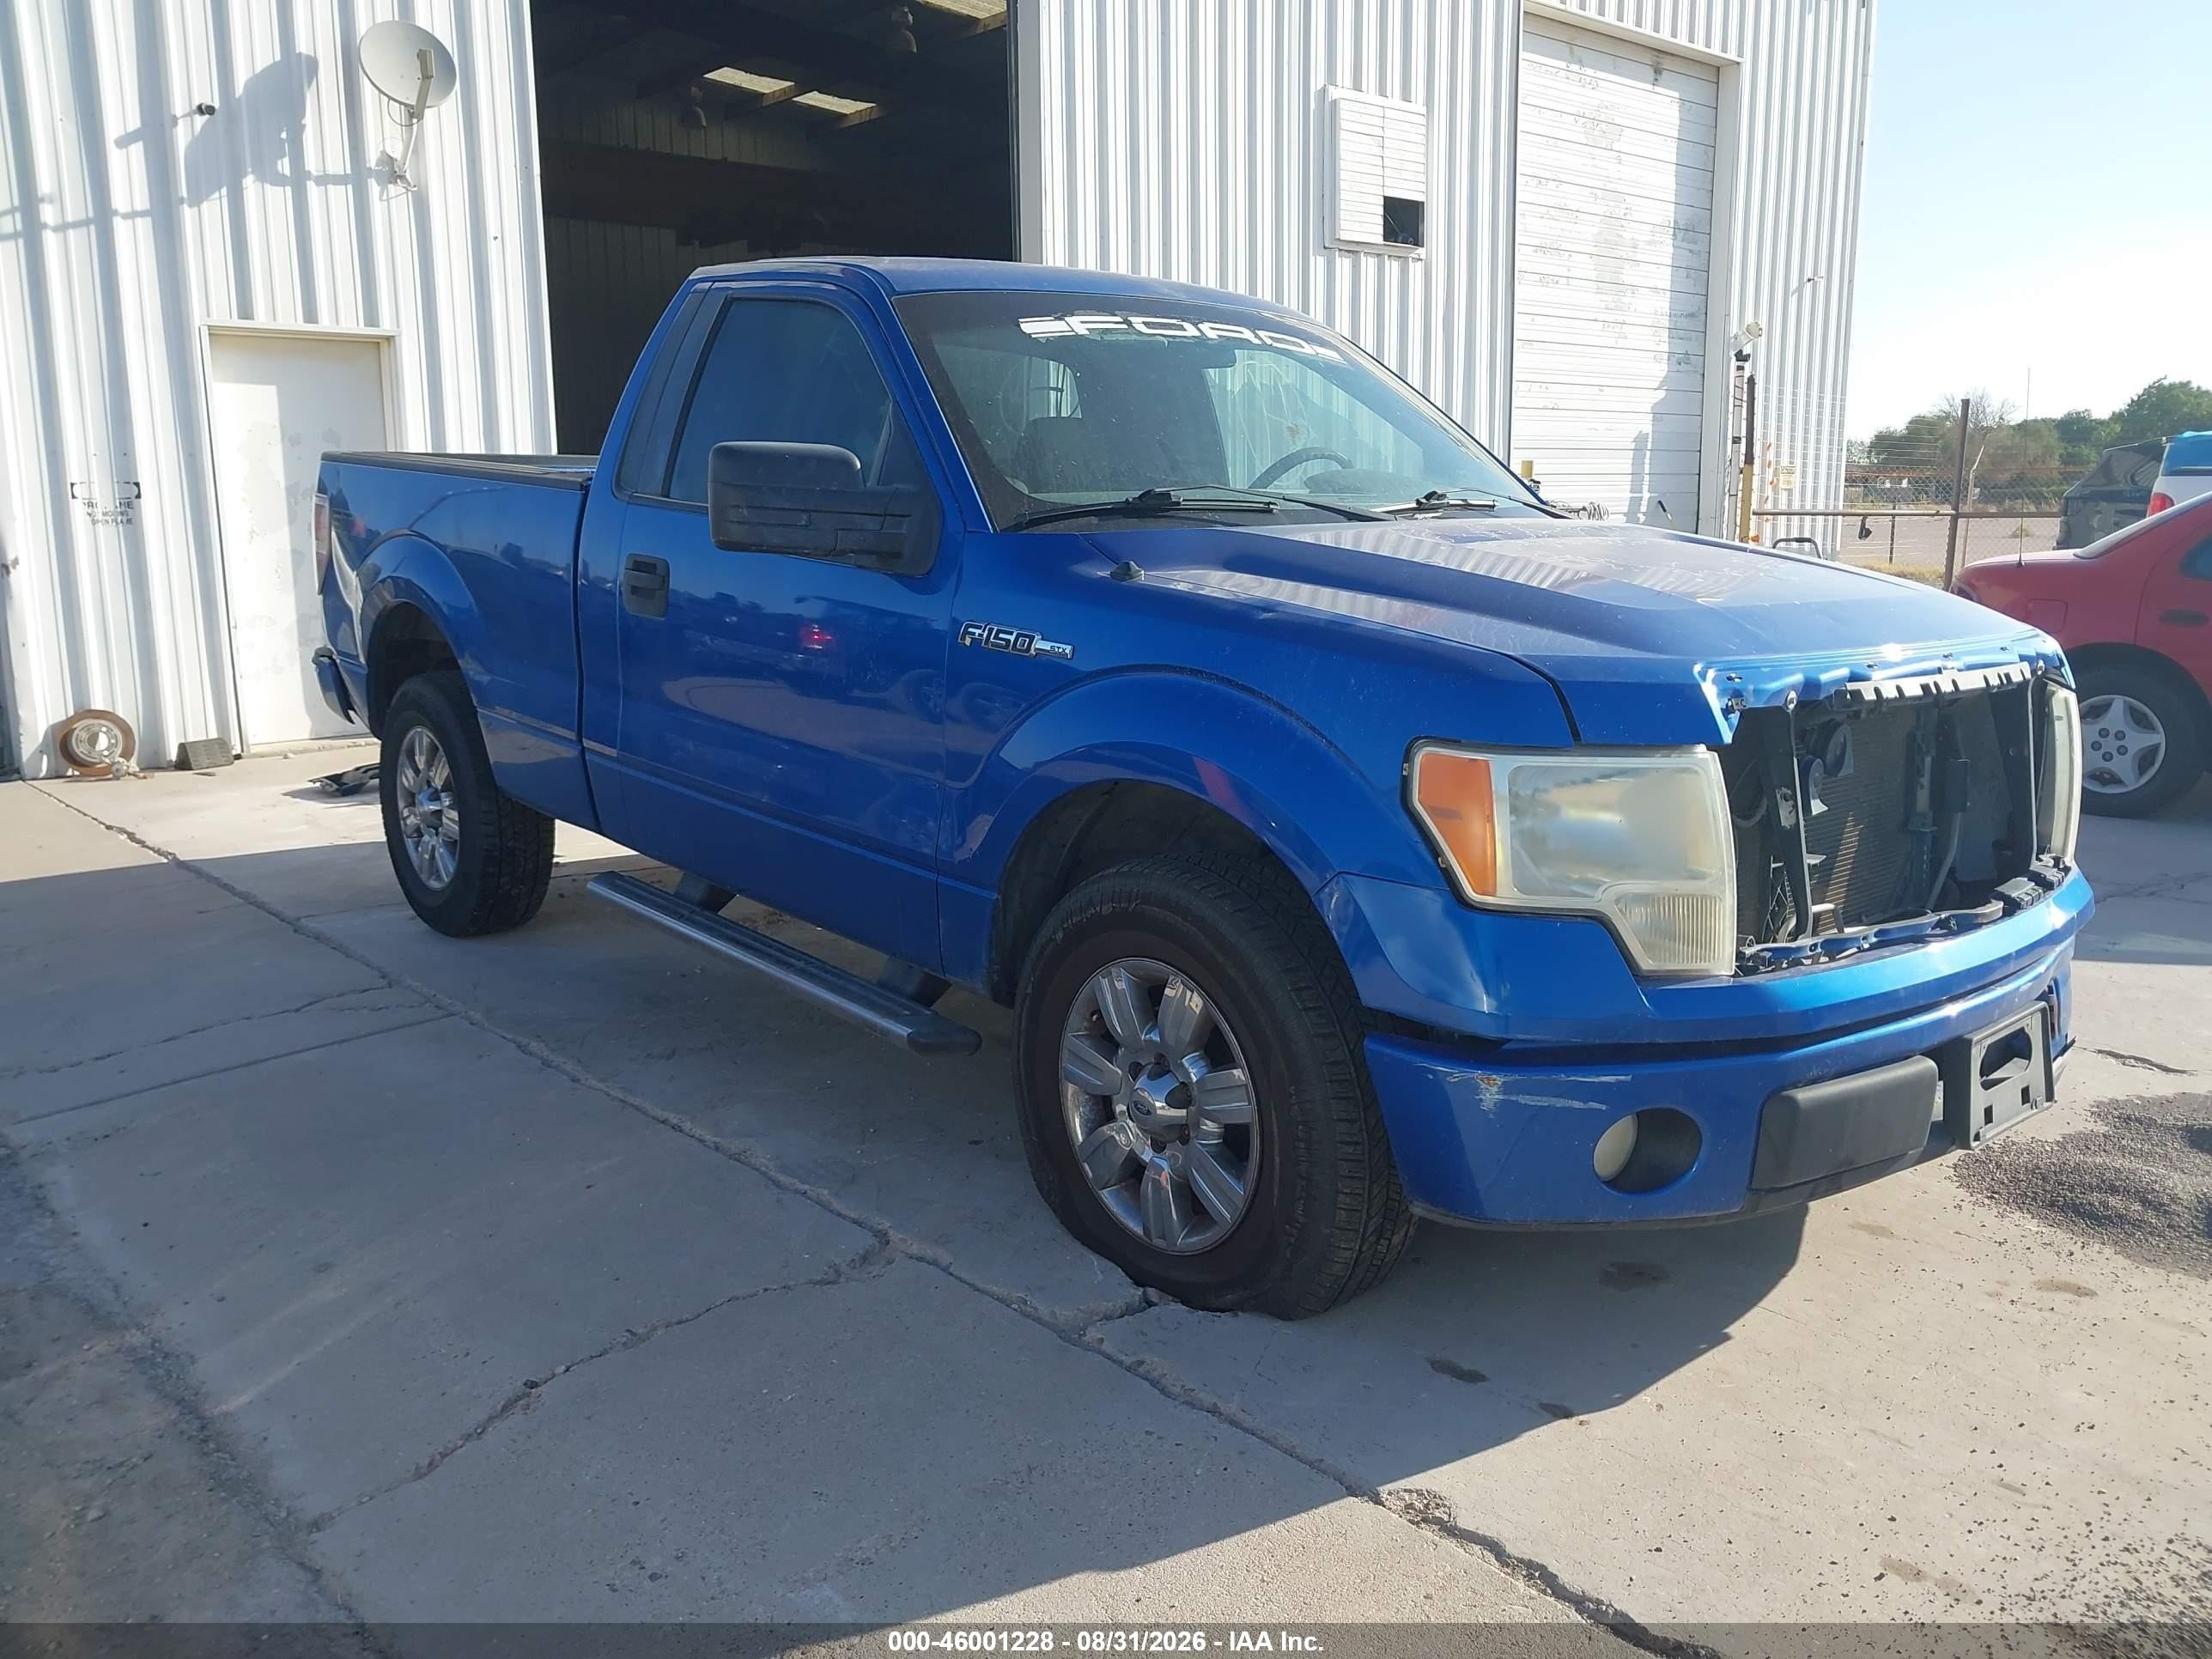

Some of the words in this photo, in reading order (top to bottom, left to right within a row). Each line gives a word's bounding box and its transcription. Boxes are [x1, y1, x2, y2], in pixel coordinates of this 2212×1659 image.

[1064, 314, 1321, 356] FORD
[957, 621, 1037, 657] F-150
[1049, 645, 1067, 653] STX
